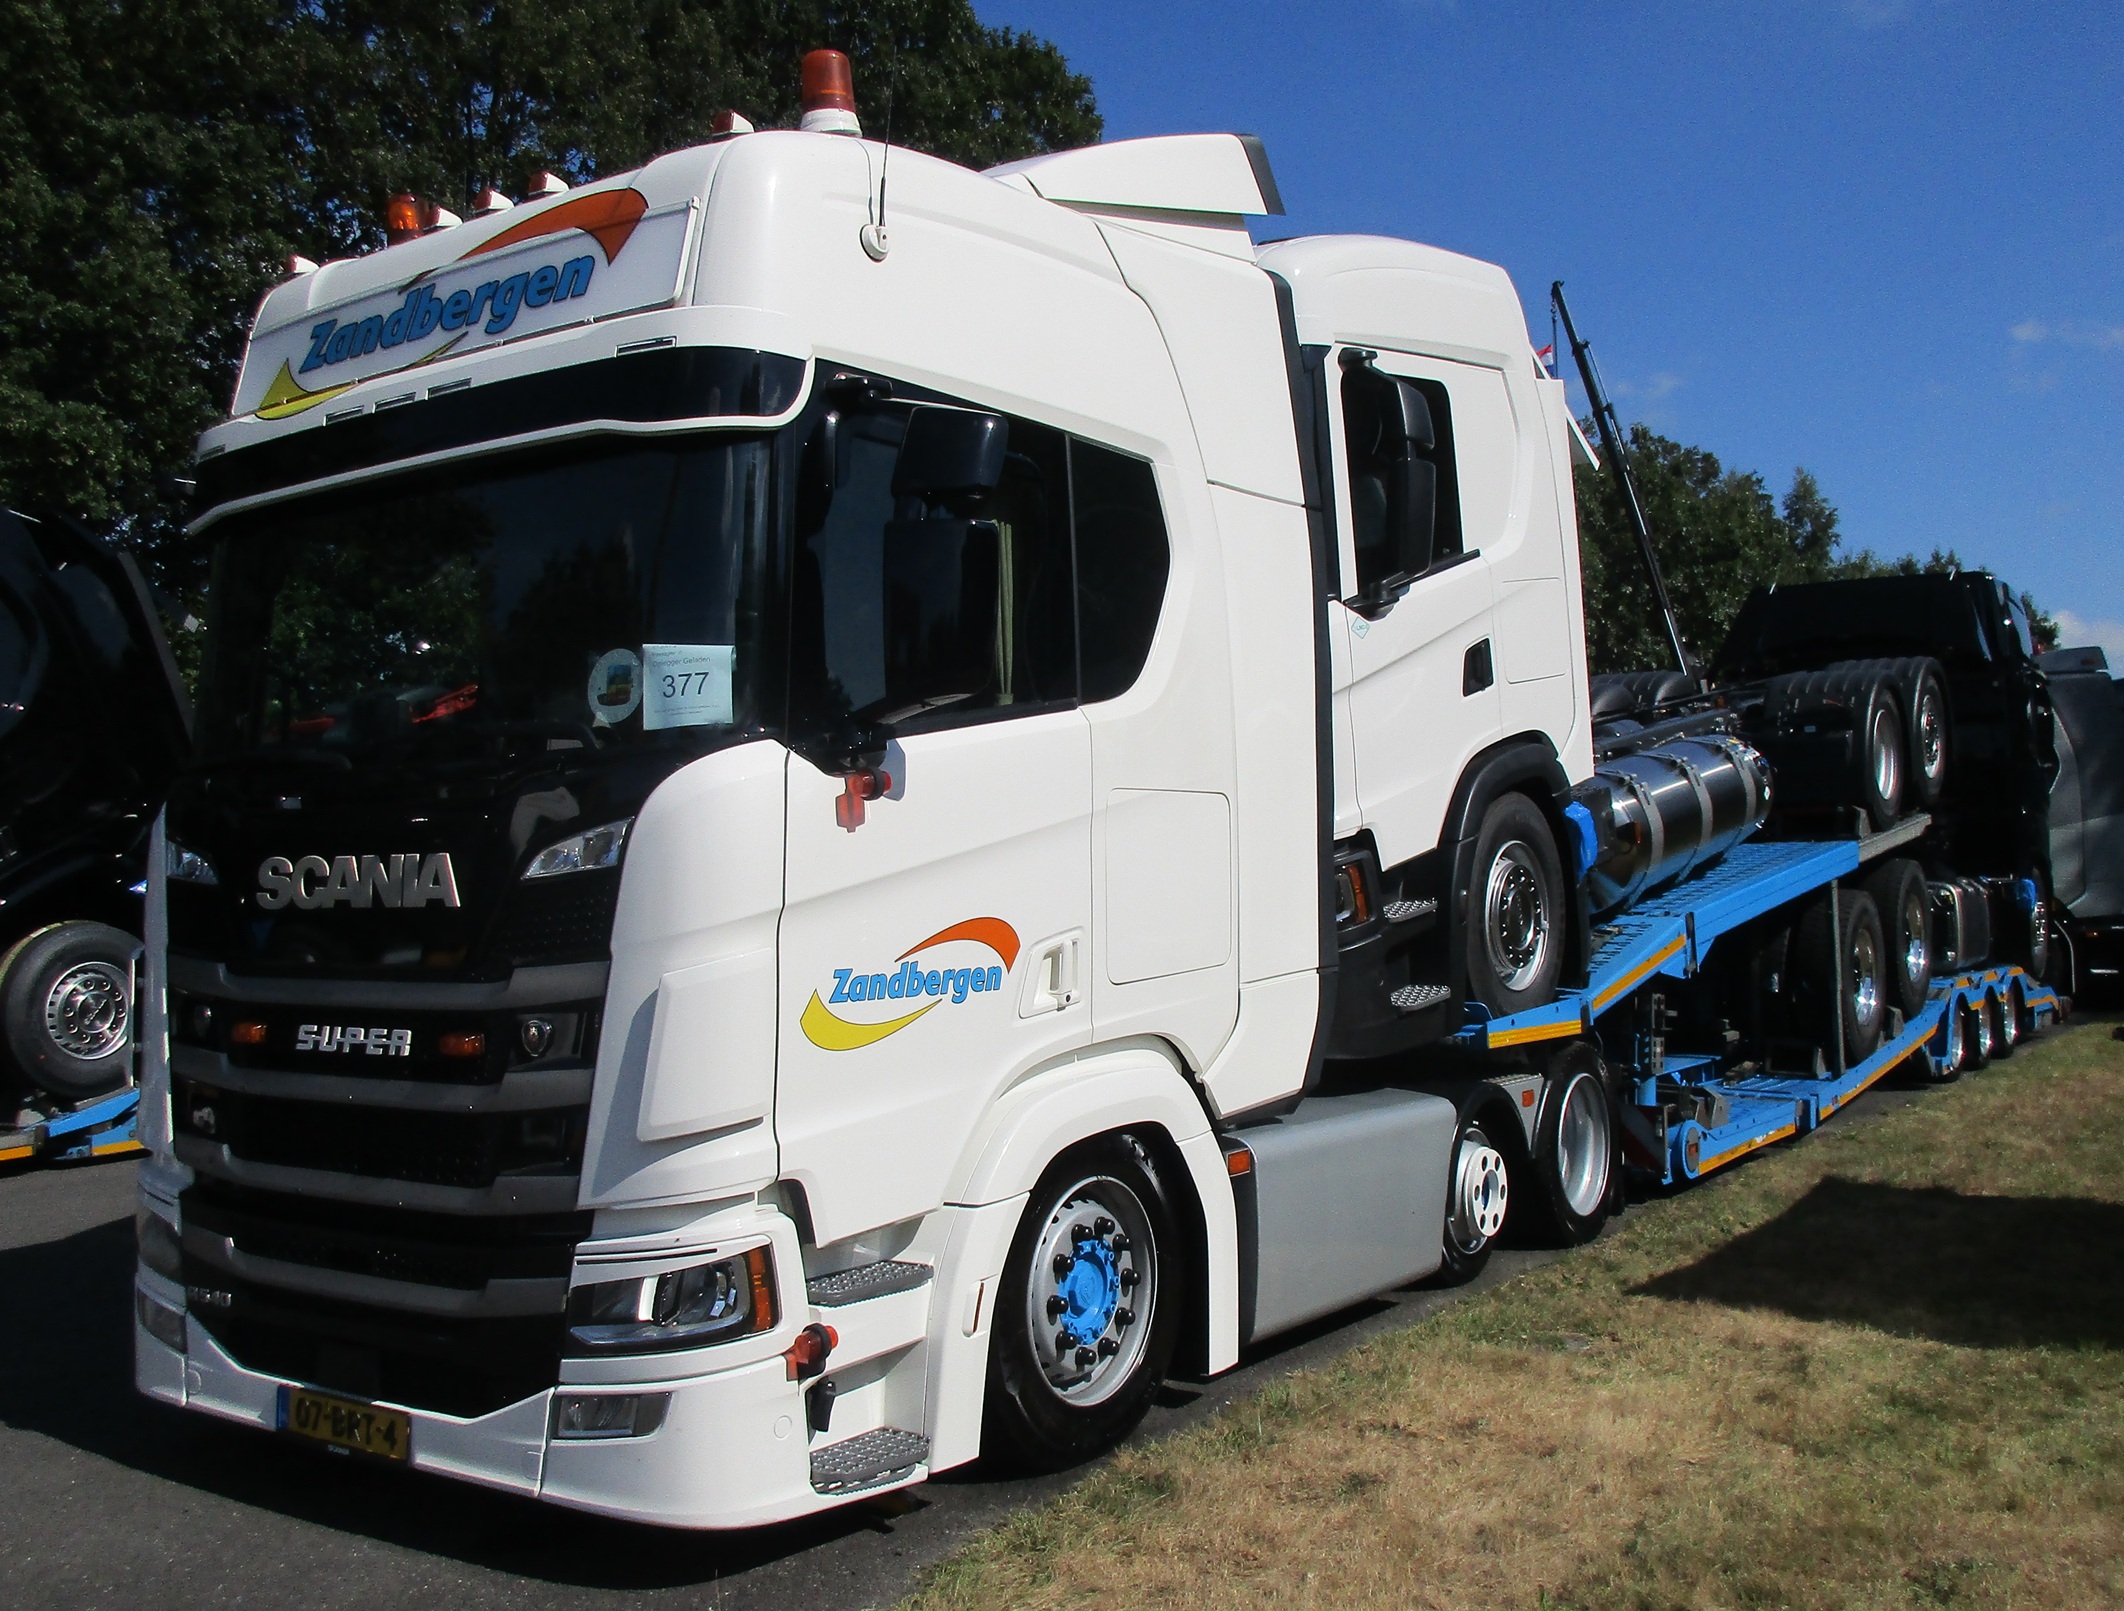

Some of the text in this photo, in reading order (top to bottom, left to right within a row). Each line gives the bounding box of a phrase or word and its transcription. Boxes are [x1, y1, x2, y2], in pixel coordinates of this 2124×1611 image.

[299, 254, 596, 374] Zandbergen
[662, 671, 710, 698] 377
[256, 852, 461, 910] SCANIA
[828, 960, 1003, 1004] Zandbergen
[295, 1023, 412, 1057] SUPER
